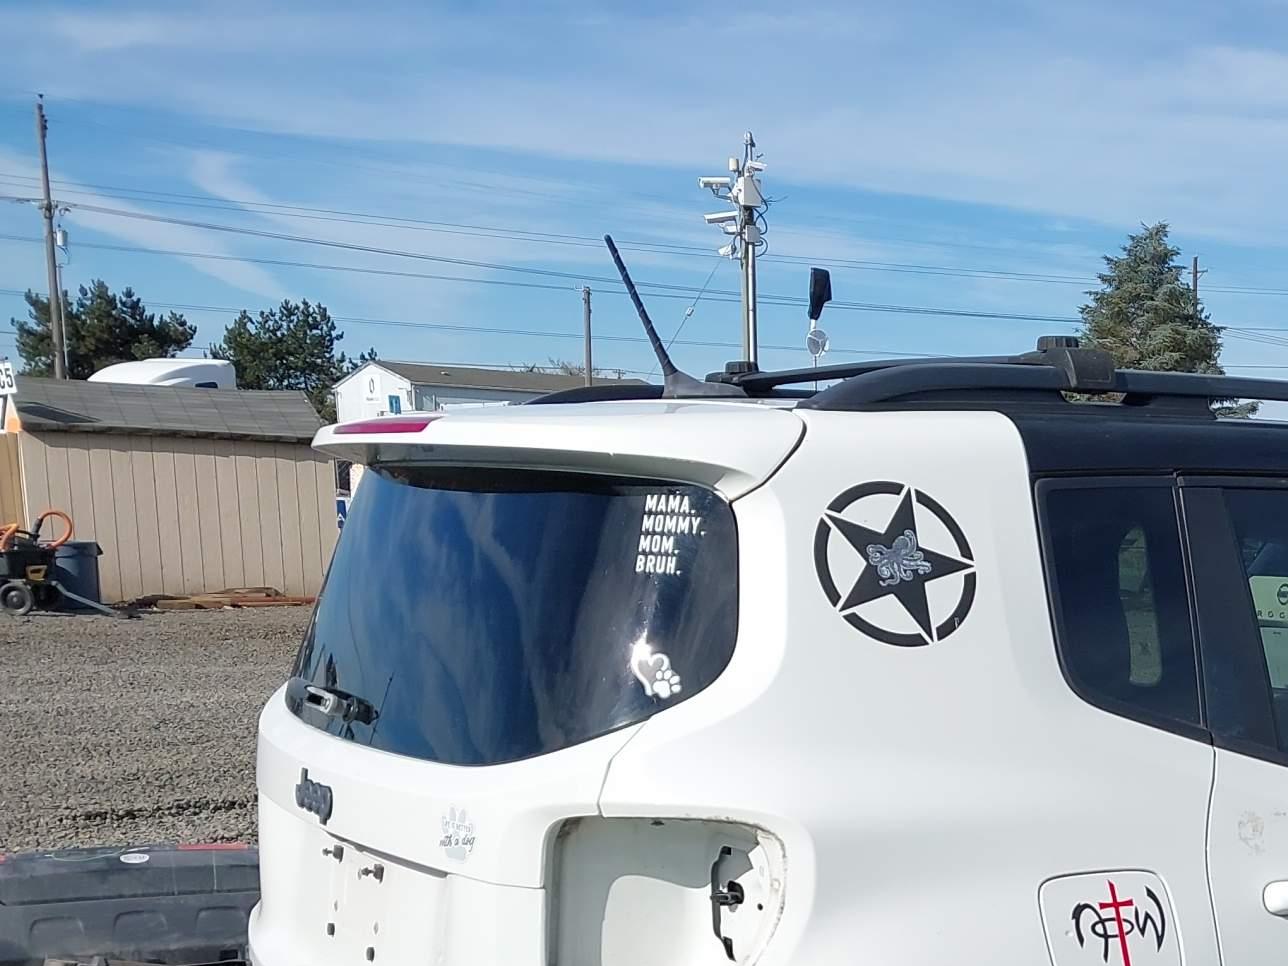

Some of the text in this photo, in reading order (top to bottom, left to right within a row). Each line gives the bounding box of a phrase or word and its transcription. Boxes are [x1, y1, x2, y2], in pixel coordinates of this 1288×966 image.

[645, 494, 696, 513] MAMA.
[641, 514, 706, 536] MOMMY.
[638, 535, 679, 554] MOM.
[635, 554, 681, 575] BRUH.
